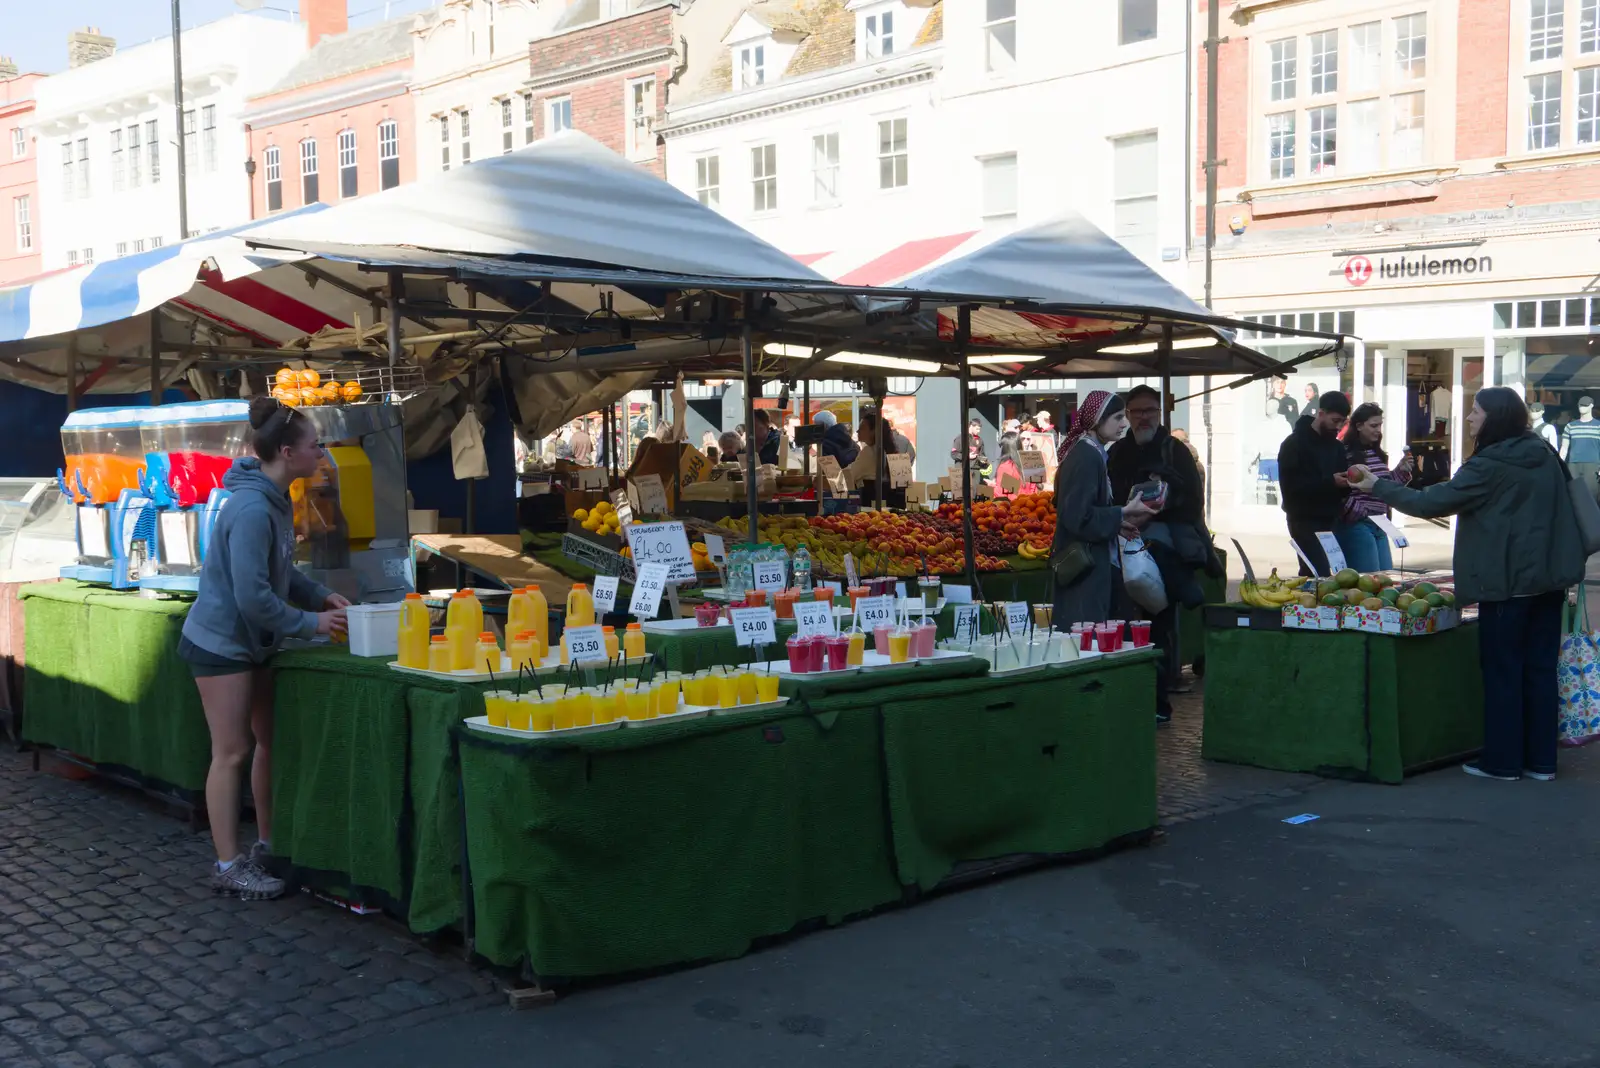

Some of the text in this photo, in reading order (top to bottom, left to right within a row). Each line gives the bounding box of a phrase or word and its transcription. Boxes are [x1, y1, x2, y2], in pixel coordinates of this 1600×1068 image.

[1380, 254, 1492, 279] lululemon
[630, 524, 682, 536] STRAWBERRY POTS
[640, 579, 658, 590] £3.50
[759, 573, 782, 584] £3.50
[595, 588, 613, 600] £8.50
[641, 591, 648, 600] 2
[634, 601, 652, 612] £6.00
[742, 620, 768, 632] £4.00
[572, 640, 599, 653] £3.50
